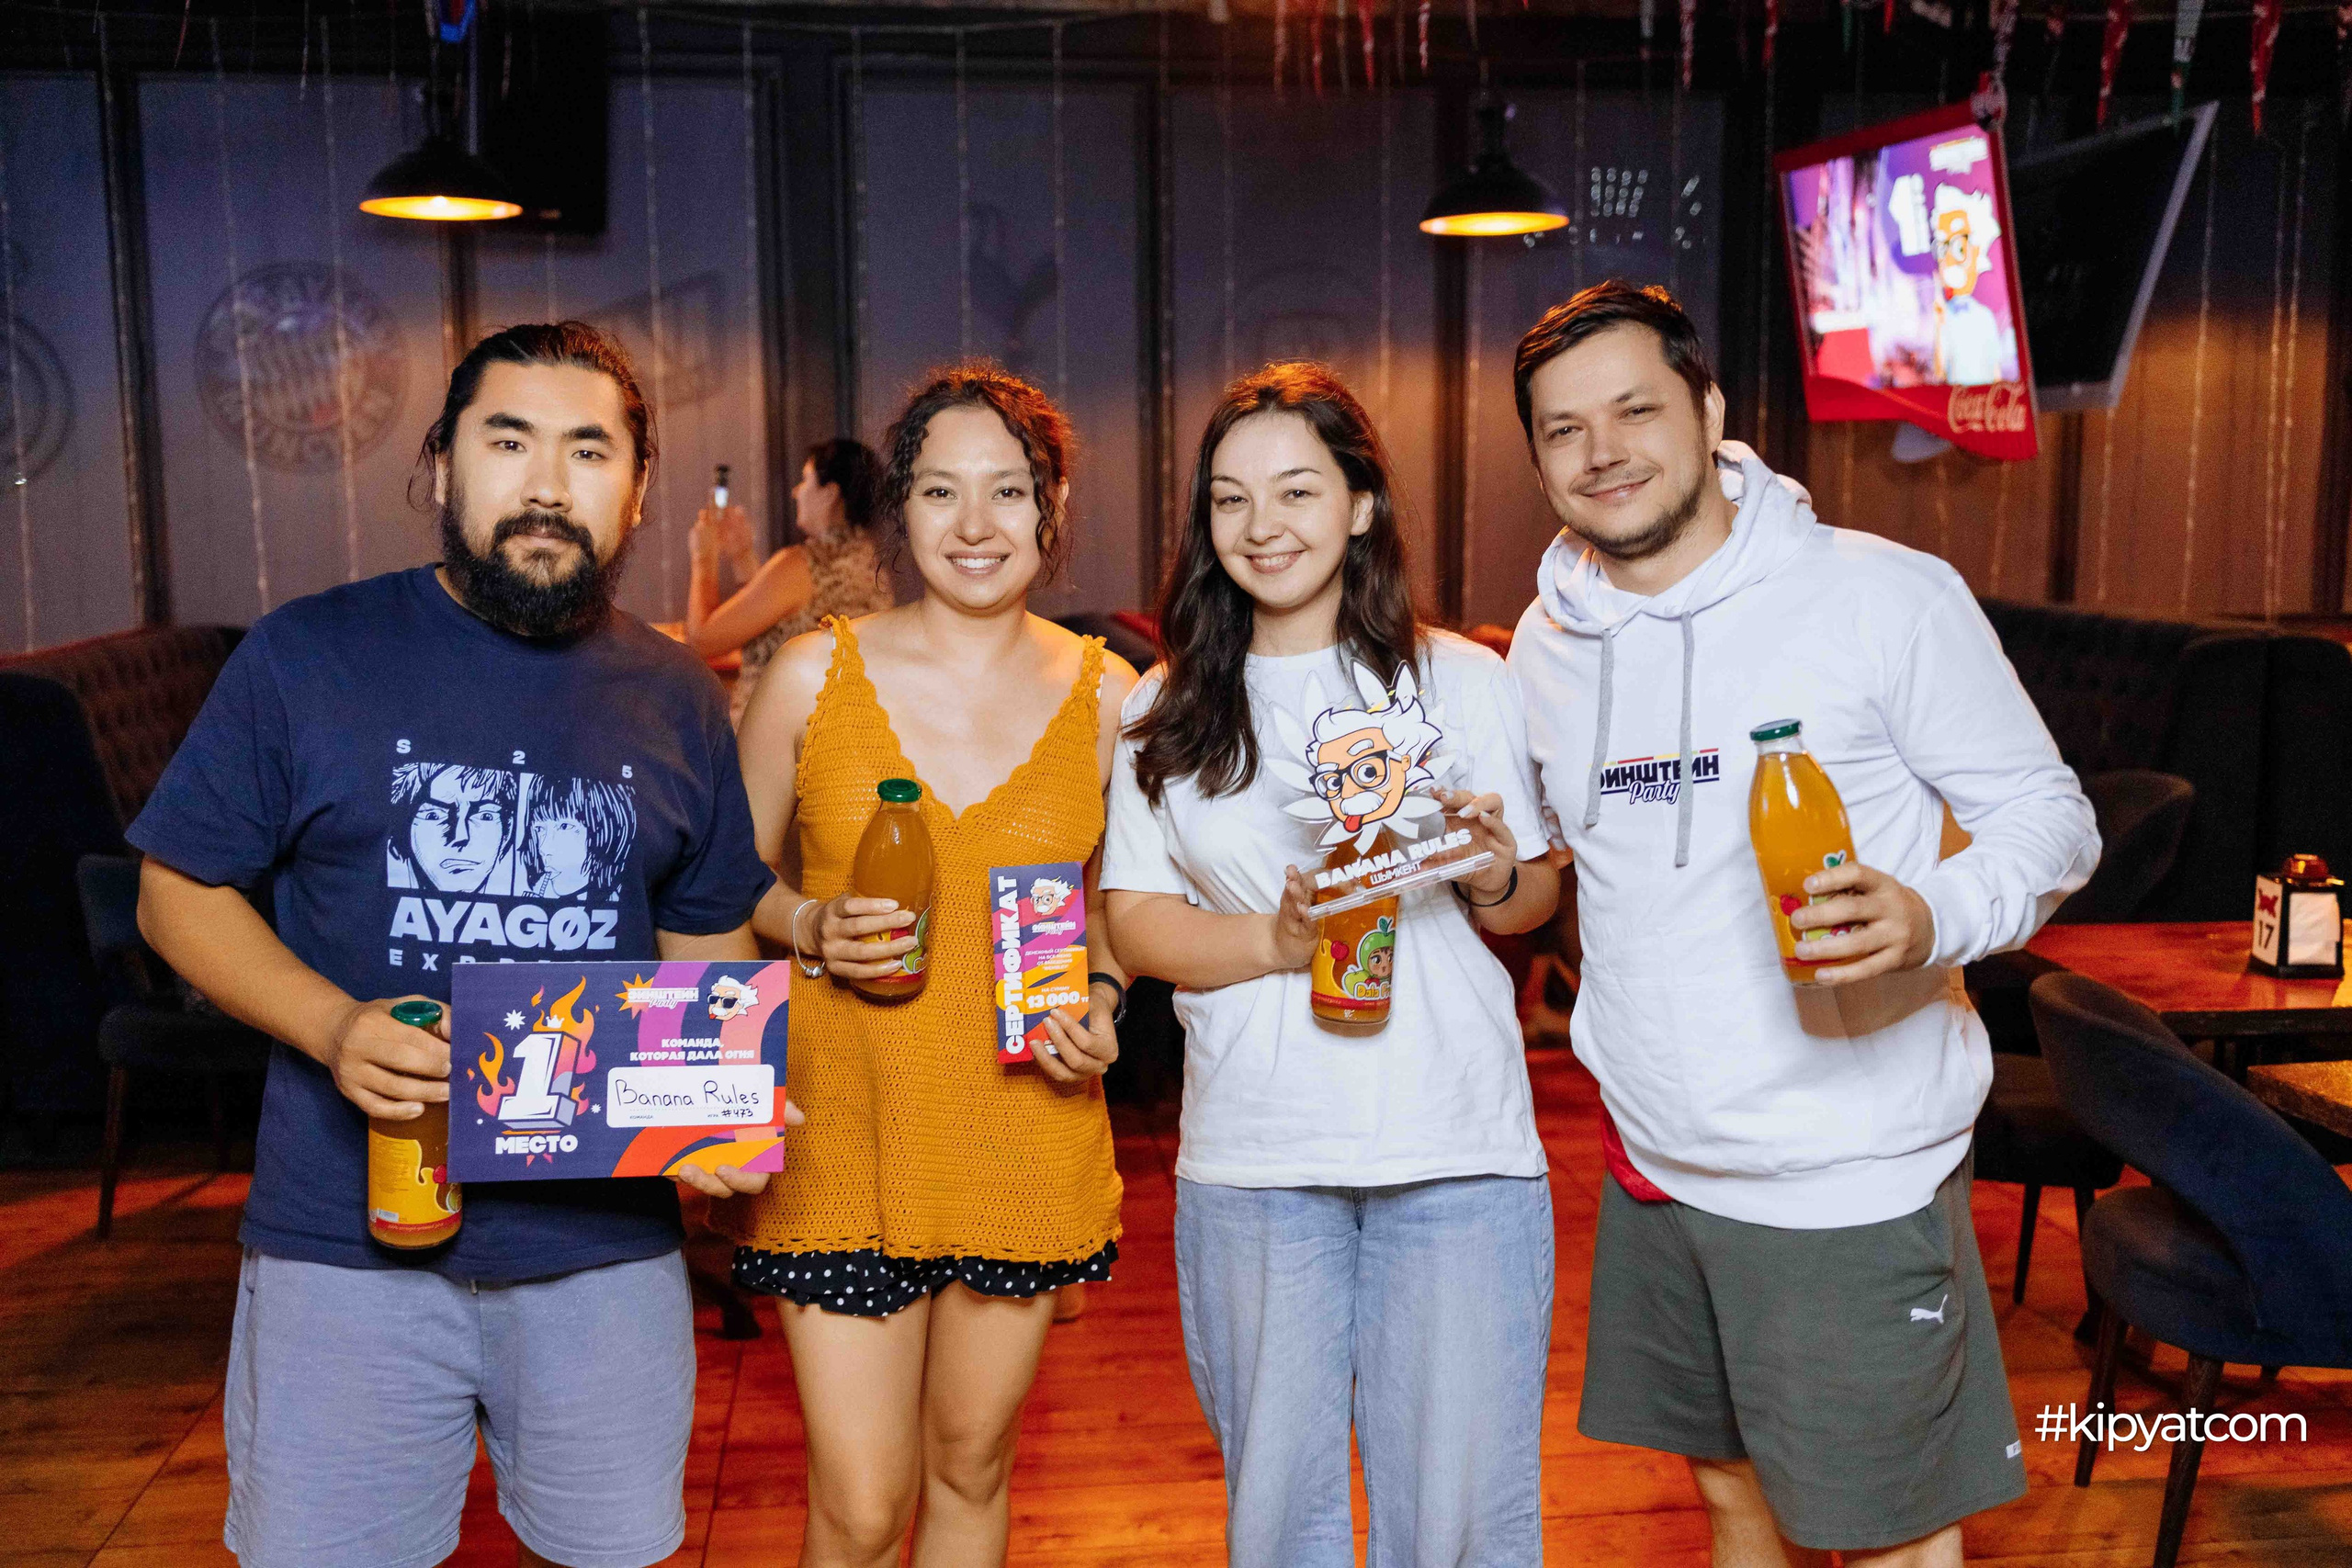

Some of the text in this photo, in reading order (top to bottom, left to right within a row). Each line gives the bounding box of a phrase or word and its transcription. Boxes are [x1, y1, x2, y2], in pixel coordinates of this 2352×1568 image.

[396, 739, 633, 778] S 2 5
[1629, 780, 1680, 805] Party
[1315, 828, 1472, 889] BANANA RULES
[1370, 862, 1421, 885] ШЫМКЕНТ
[2258, 919, 2274, 950] 17
[998, 875, 1024, 1055] СЕРТИФИКАТ
[1026, 995, 1045, 1009] 13
[1046, 991, 1080, 1007] 000
[662, 1037, 724, 1048] КОМАНДА,
[629, 1049, 755, 1062] КОТОРАЯ ДАЛА ОГНЯ
[497, 1031, 571, 1123] 1
[615, 1078, 760, 1106] Banana Rules
[721, 1108, 753, 1119] #473
[495, 1134, 578, 1155] МЕСТО
